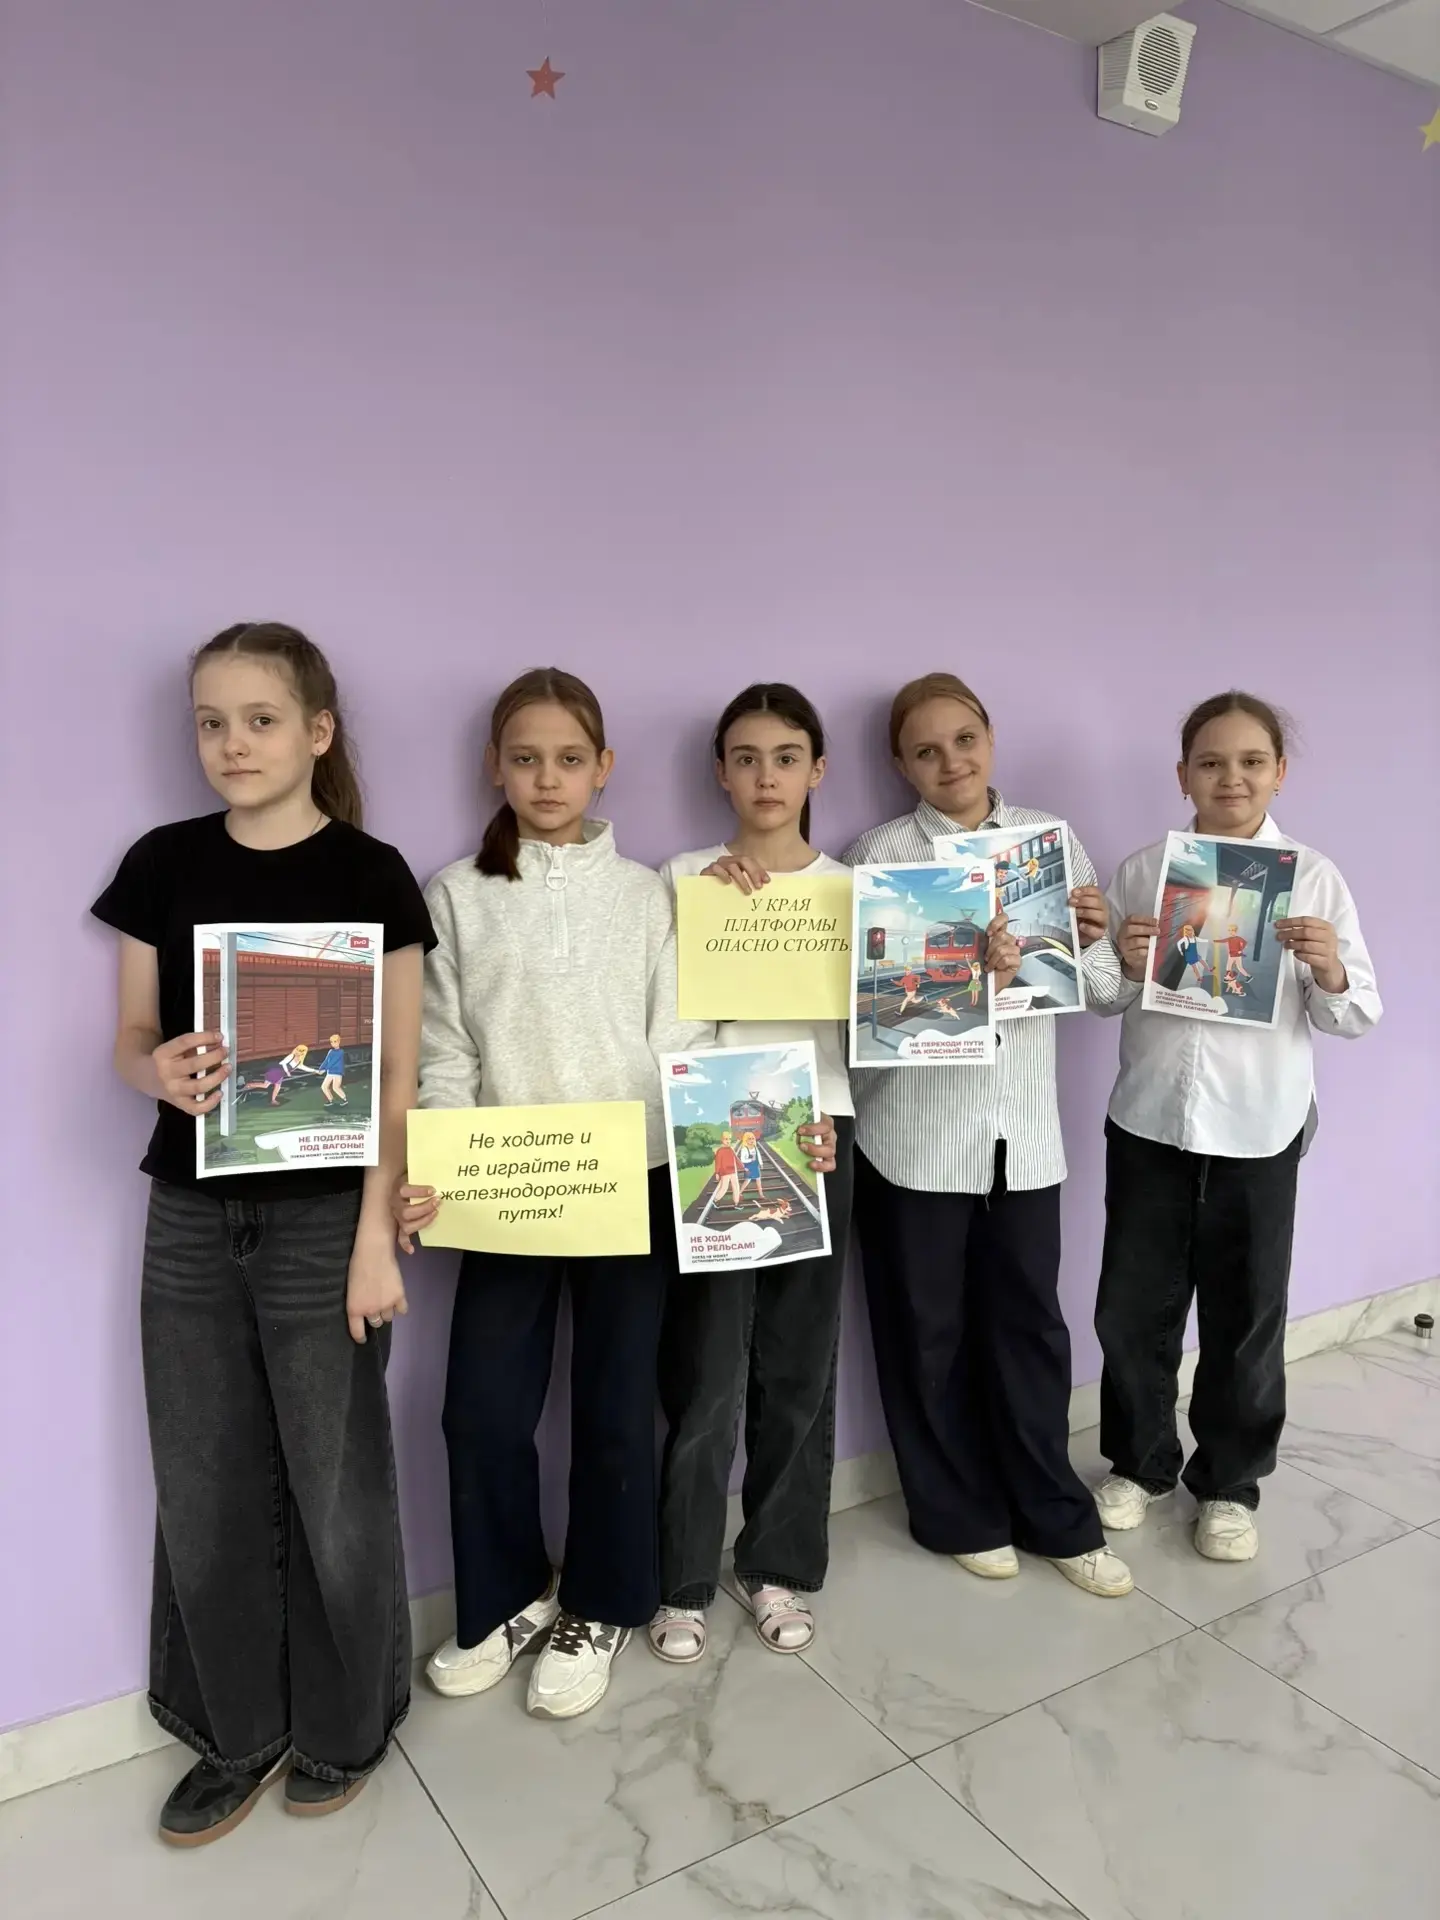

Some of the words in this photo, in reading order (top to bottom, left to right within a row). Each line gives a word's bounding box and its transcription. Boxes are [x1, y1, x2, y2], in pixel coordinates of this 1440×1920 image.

[751, 899, 762, 912] У
[766, 898, 812, 912] КРАЯ
[724, 918, 837, 932] ПЛАТФОРМЫ
[705, 938, 779, 952] ОПАСНО
[298, 1135, 311, 1143] НЕ
[313, 1133, 365, 1143] ПОДЛЕЗАЙ
[468, 1132, 495, 1149] Не
[501, 1130, 574, 1148] ходите
[580, 1132, 592, 1144] и
[322, 1142, 364, 1150] ВАГОНЫ!
[457, 1163, 480, 1177] не
[486, 1157, 570, 1178] играйте
[576, 1158, 598, 1172] на
[440, 1180, 618, 1201] железнодорожных
[498, 1204, 564, 1223] путях!
[705, 1234, 732, 1242] ХОДИ
[707, 1241, 755, 1252] РЕЛЬСАМ!
